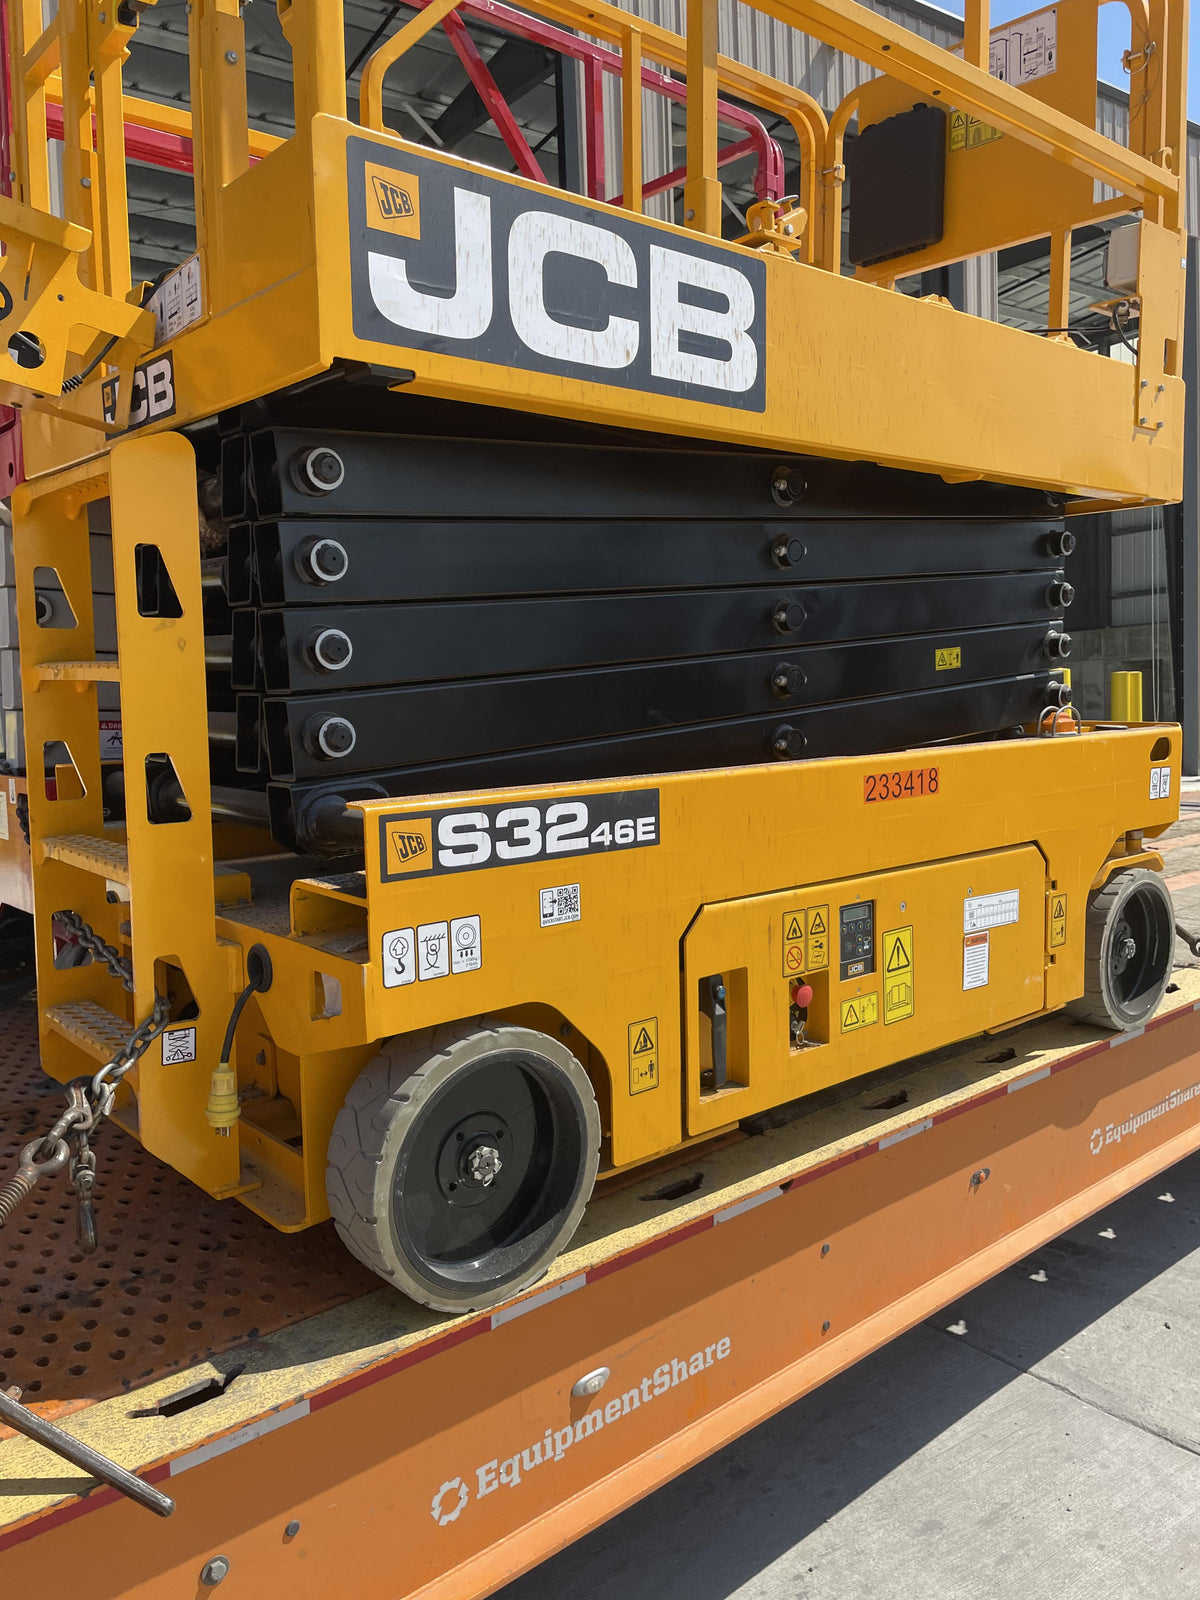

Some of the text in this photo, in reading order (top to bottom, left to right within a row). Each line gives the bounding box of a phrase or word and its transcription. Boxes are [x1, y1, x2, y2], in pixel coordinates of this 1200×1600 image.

[379, 182, 412, 216] JCB
[367, 186, 758, 393] JCB
[866, 767, 938, 802] 233418
[397, 833, 425, 859] JCB
[849, 964, 863, 974] JCB
[476, 1336, 731, 1500] EquipmentShare
